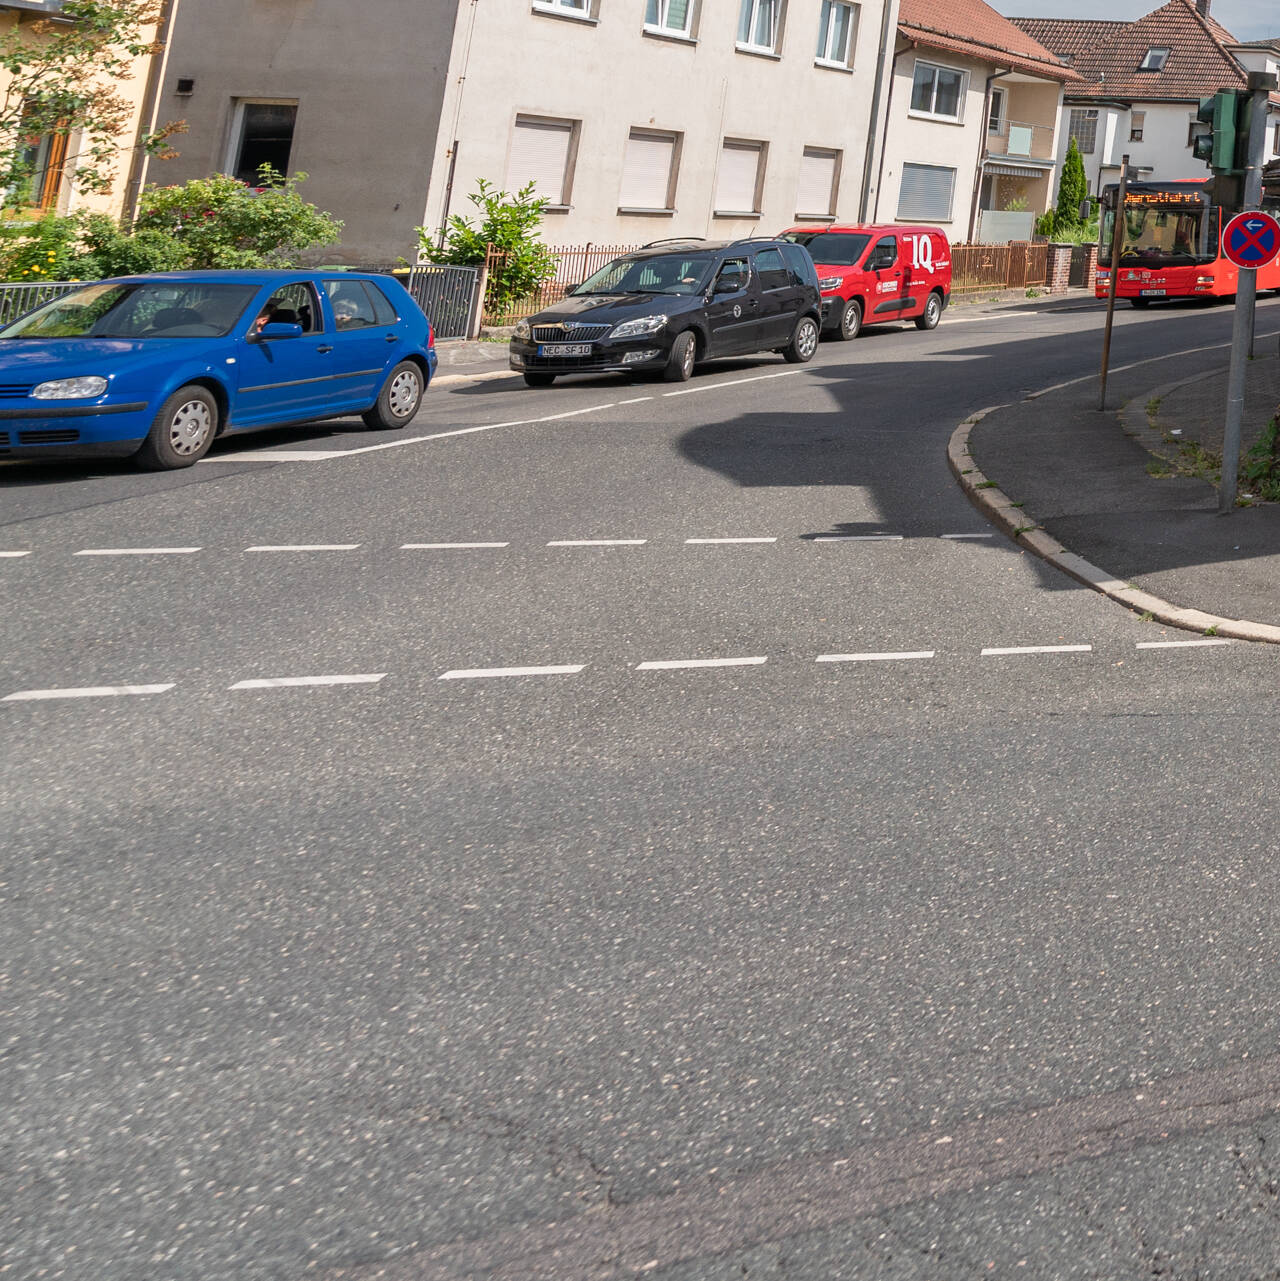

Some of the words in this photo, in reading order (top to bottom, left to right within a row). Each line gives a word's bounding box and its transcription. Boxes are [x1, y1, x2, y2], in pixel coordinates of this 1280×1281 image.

[912, 234, 935, 274] IQ
[543, 346, 560, 355] NEC
[565, 346, 576, 354] SF
[579, 345, 590, 354] 10
